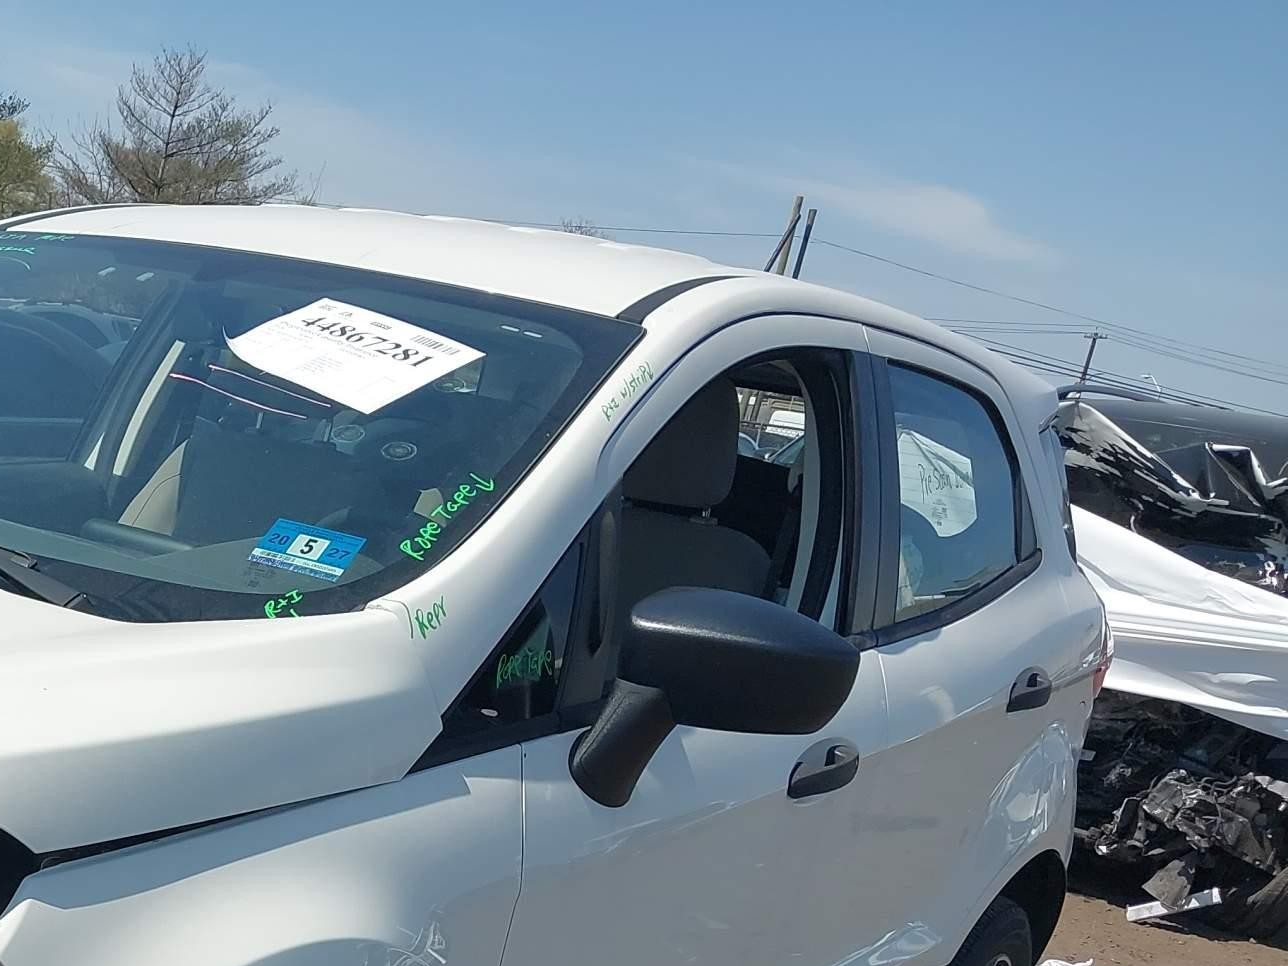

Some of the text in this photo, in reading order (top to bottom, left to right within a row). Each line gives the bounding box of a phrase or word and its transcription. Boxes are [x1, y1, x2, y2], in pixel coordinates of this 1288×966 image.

[302, 317, 434, 367] 44867281
[268, 532, 291, 546] 20
[299, 538, 318, 555] 5
[326, 547, 352, 561] 27
